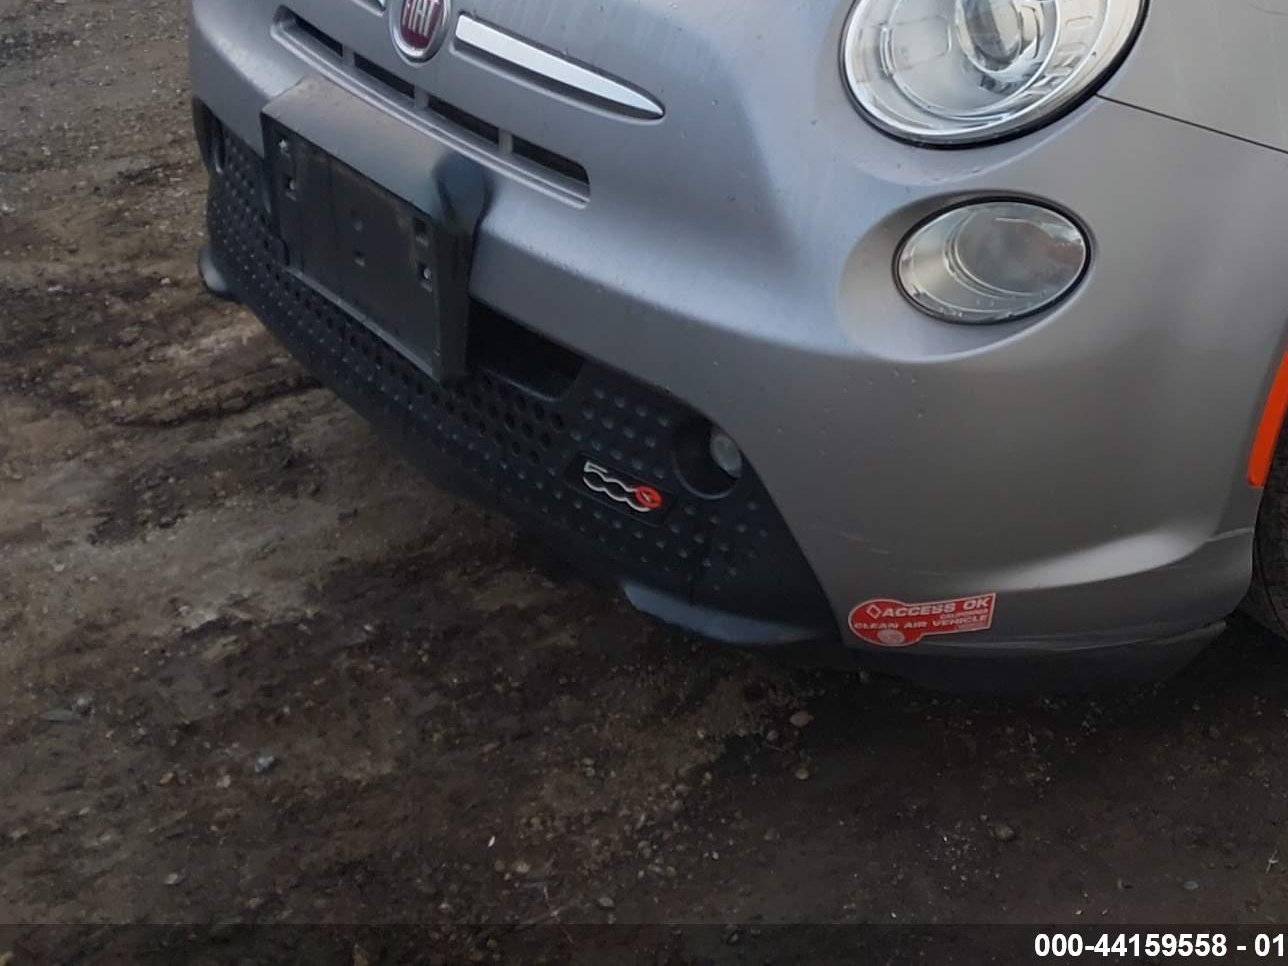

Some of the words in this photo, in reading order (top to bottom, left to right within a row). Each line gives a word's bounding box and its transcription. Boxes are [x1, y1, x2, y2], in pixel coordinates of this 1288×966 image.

[882, 602, 956, 618] ACCESS
[963, 597, 990, 611] OK
[854, 621, 899, 630] CLEAN
[903, 620, 929, 629] AIR
